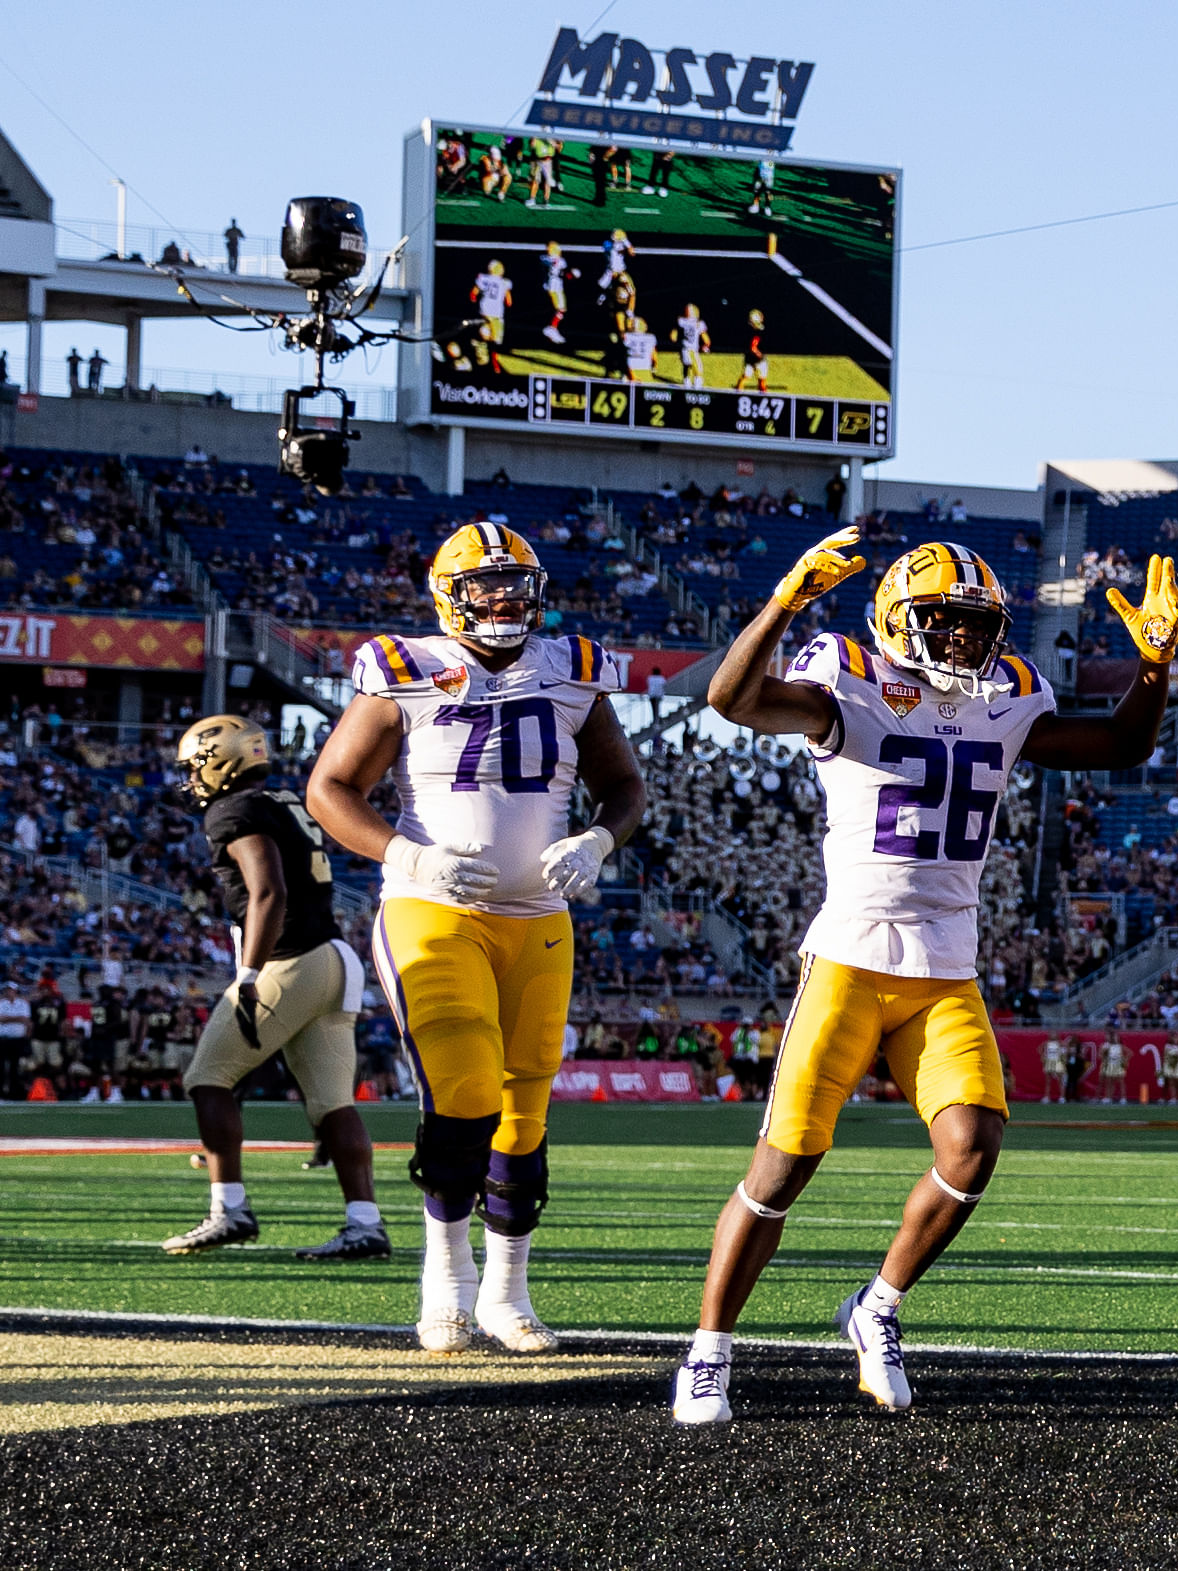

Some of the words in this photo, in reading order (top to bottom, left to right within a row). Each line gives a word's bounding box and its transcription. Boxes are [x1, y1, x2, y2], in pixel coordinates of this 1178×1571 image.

[538, 27, 816, 119] MASSEY
[541, 106, 705, 138] SERVICES
[719, 126, 782, 145] INC.
[551, 391, 587, 410] LSU
[592, 391, 628, 419] 49
[738, 396, 784, 420] 8:47
[650, 404, 665, 427] 2
[689, 407, 704, 430] 8
[806, 407, 824, 434] 7
[934, 725, 962, 735] LSU
[433, 698, 559, 793] 70
[873, 734, 1004, 861] 26
